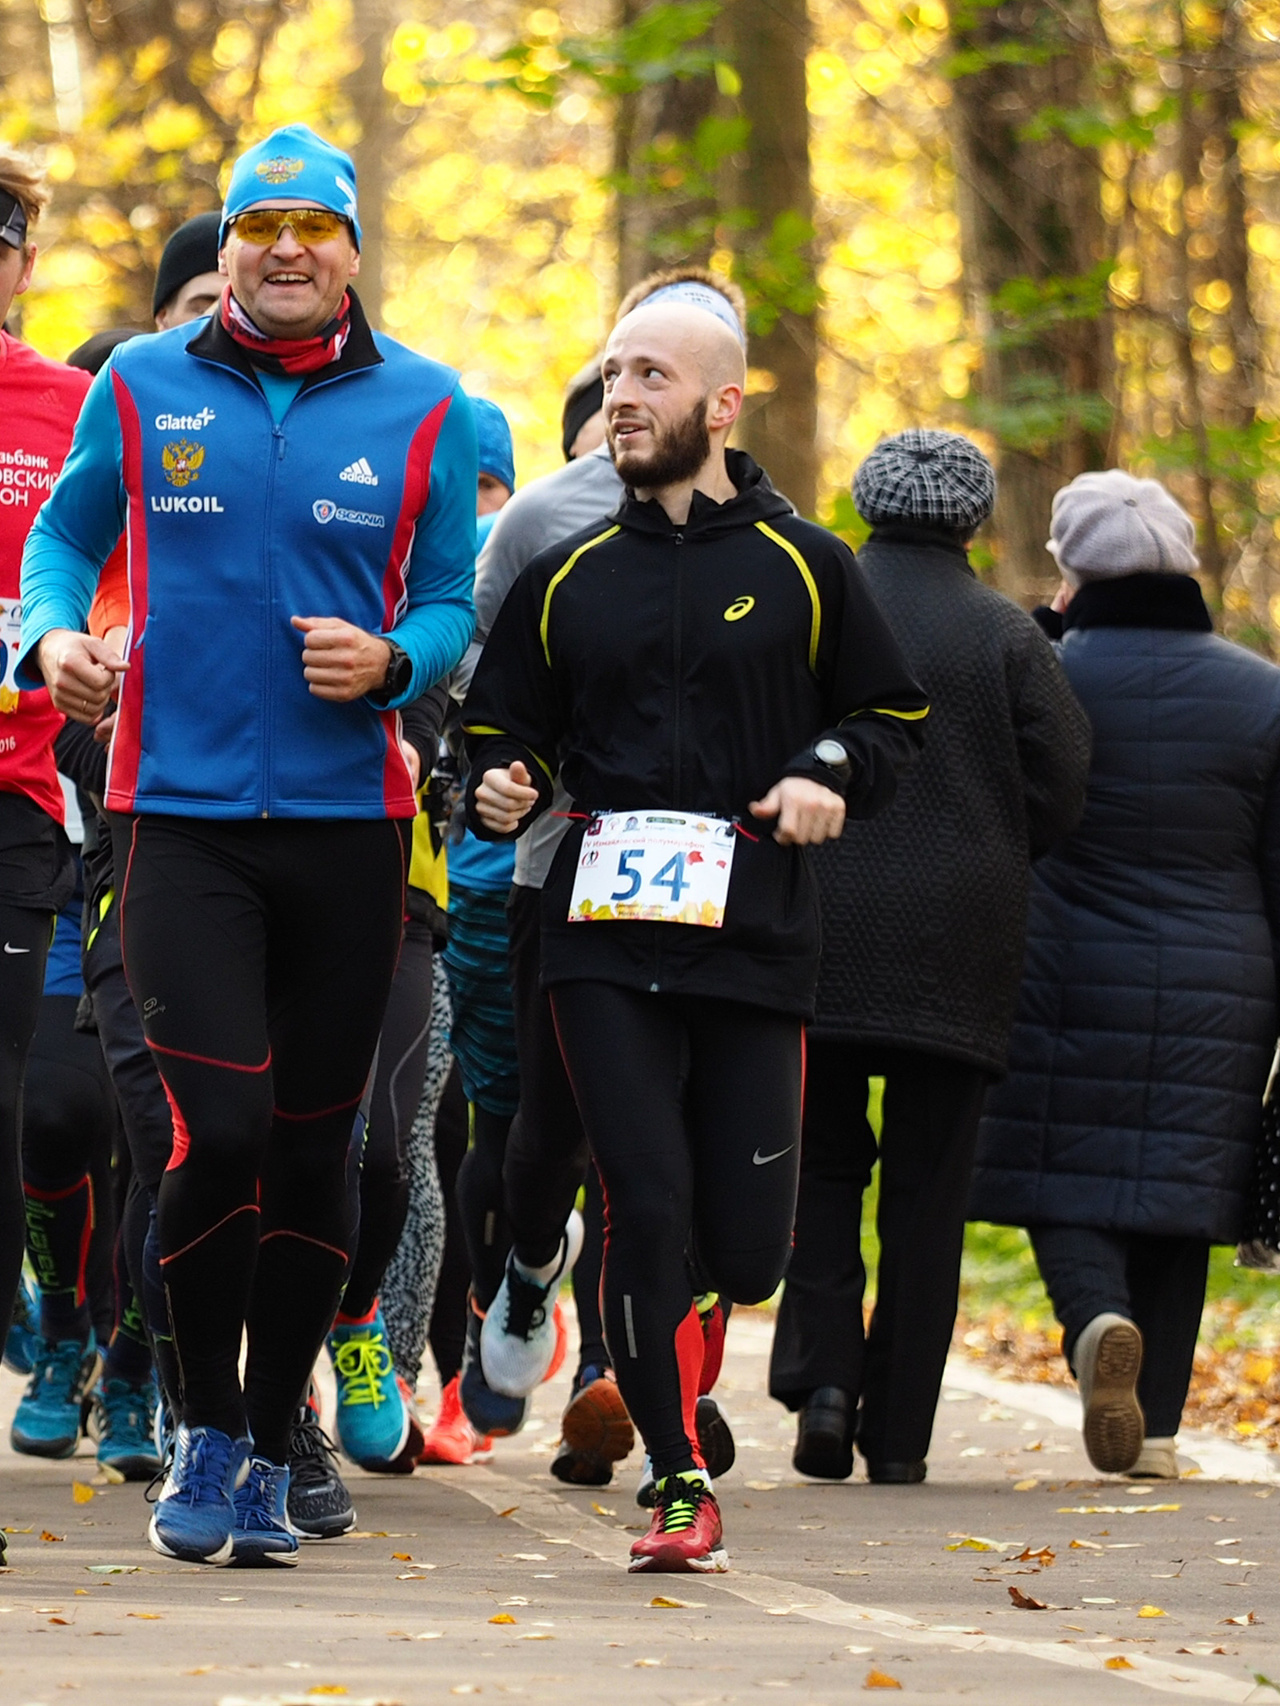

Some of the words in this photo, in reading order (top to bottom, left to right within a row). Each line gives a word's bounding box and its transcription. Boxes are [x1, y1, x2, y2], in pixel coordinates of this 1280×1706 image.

[339, 470, 378, 487] adidas
[151, 495, 224, 513] LUKOIL
[336, 508, 385, 529] SCANIA
[610, 849, 691, 902] 54
